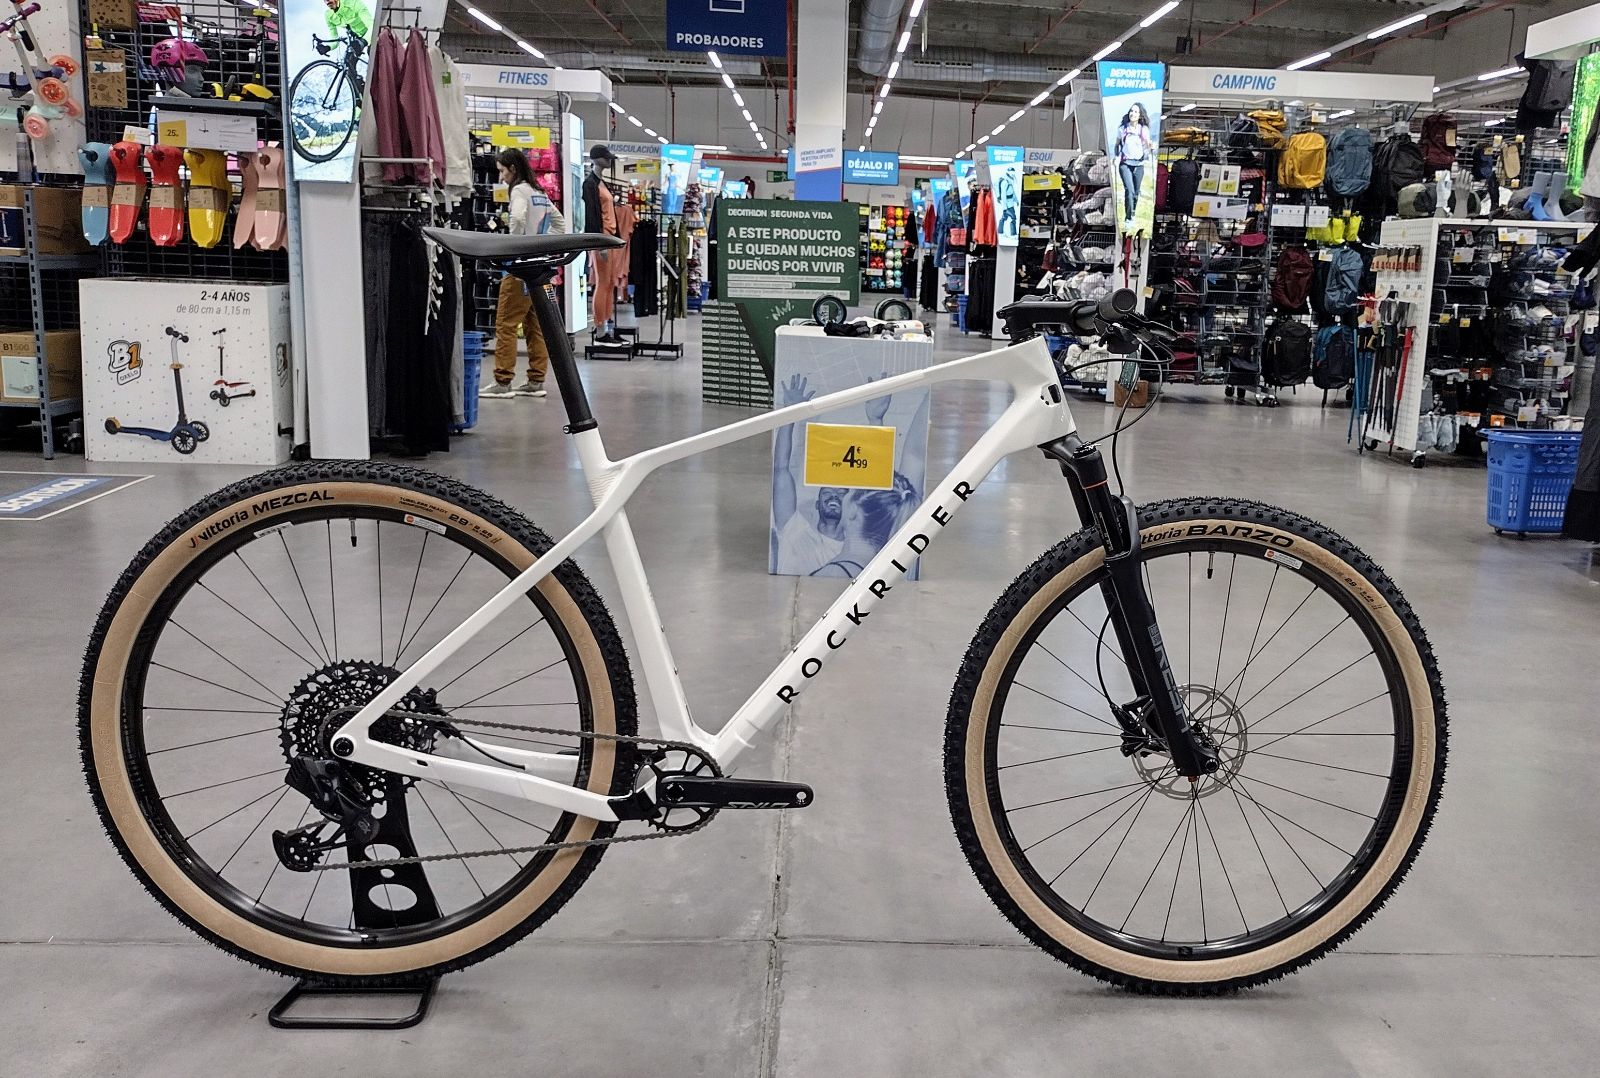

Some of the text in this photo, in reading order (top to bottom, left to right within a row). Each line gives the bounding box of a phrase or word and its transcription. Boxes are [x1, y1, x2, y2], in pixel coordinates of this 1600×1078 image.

[676, 32, 764, 49] PROBADORES
[498, 71, 548, 86] FITNESS
[1110, 68, 1151, 78] DEPORTES
[1105, 78, 1156, 89] DE MONTAÑA
[1212, 74, 1277, 91] CAMPING
[608, 144, 659, 154] MUSCULACIÓN
[1029, 151, 1055, 161] ESQUÍ
[847, 158, 894, 171] DÉJALO IR
[727, 208, 833, 220] DECATHLON SEGUNDA VIDA
[727, 227, 842, 241] A ESTE PRODUCTO
[728, 243, 856, 258] LE QUEDAN MUCHOS
[728, 257, 845, 273] DUEÑOS POR VIVIR
[201, 289, 250, 302] 2-4 AÑOS
[176, 304, 187, 313] de
[188, 304, 199, 313] 80
[224, 306, 241, 315] 1,15
[109, 341, 142, 372] B1
[199, 510, 250, 542] vittoria
[252, 489, 335, 516] MEZCAL
[1140, 527, 1183, 545] ttoria
[1187, 524, 1295, 549] BARZO
[775, 480, 976, 704] ROCKRIDER
